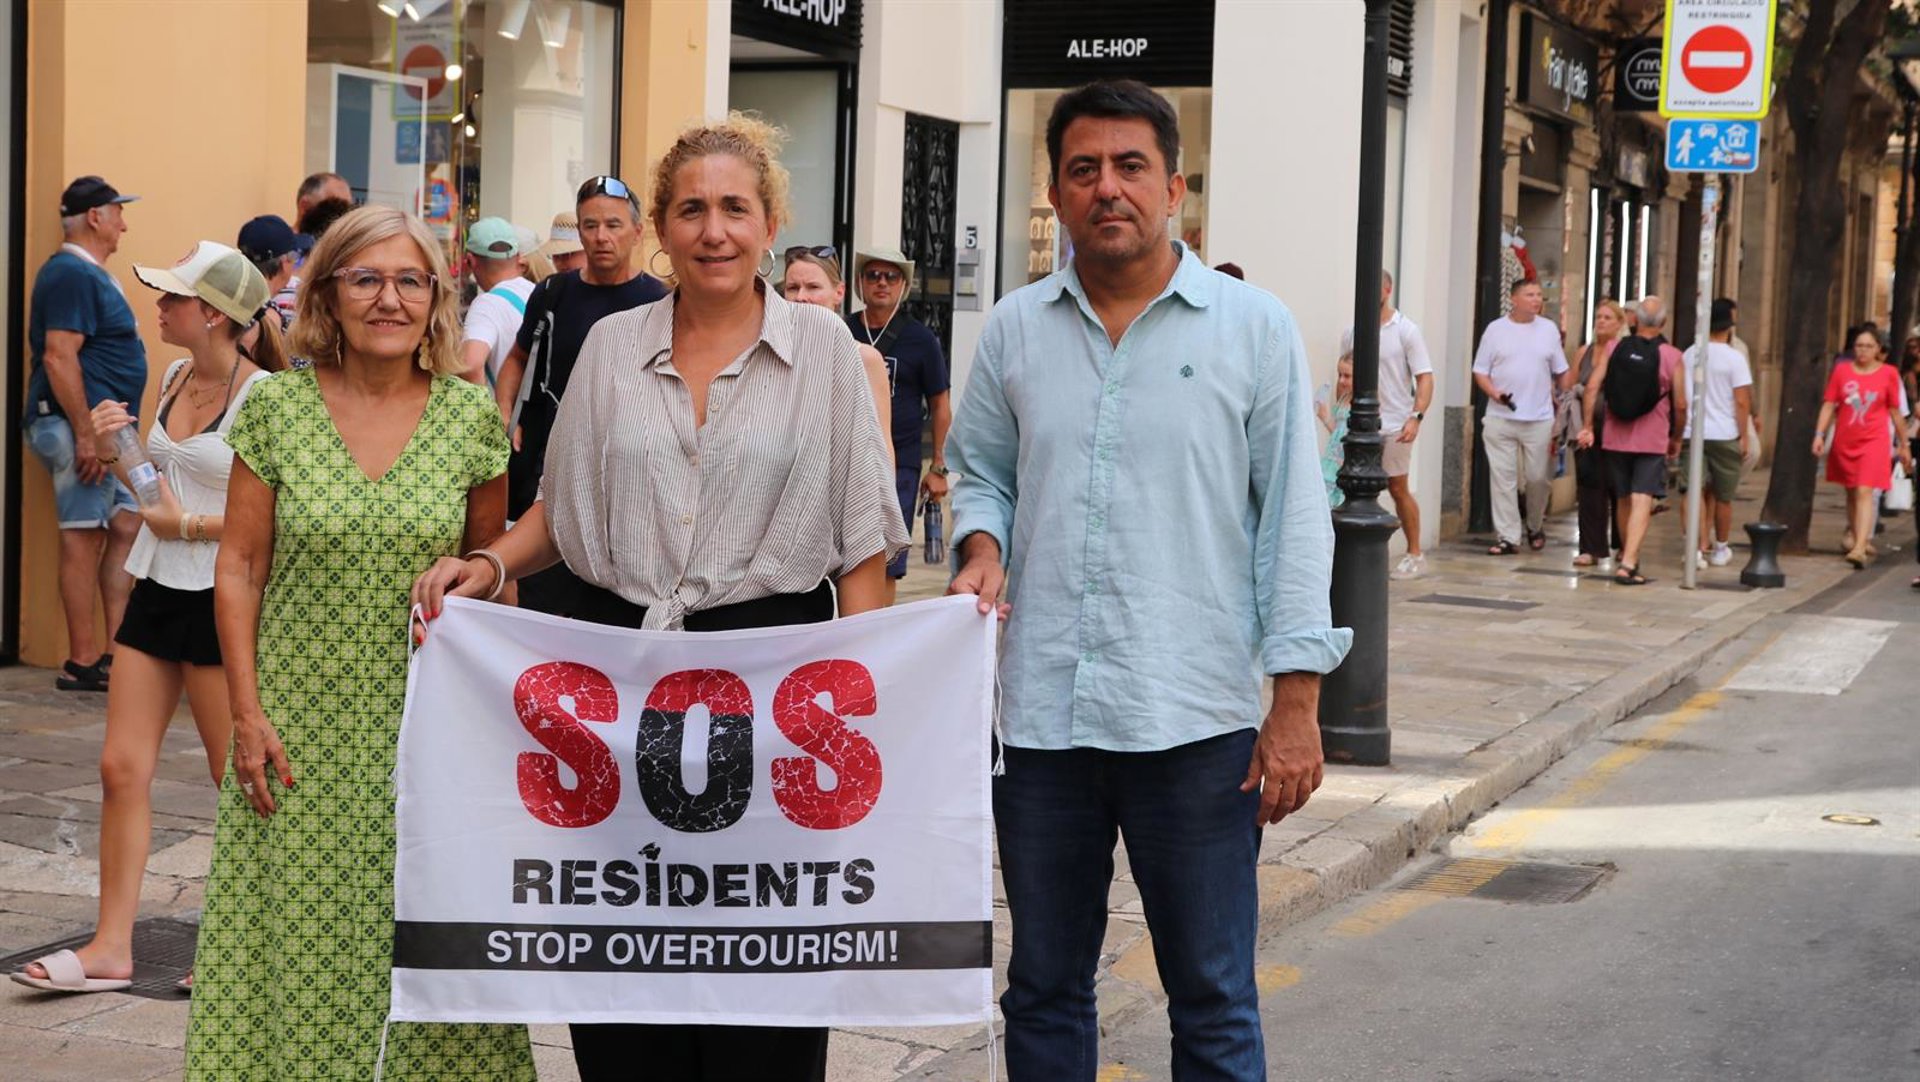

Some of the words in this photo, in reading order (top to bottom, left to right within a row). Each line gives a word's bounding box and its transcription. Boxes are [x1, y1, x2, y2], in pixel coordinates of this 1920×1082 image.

[763, 0, 846, 26] -HOP
[1067, 38, 1147, 58] ALE-HOP
[966, 229, 977, 248] 5
[513, 659, 883, 833] SOS
[486, 930, 593, 966] STOP
[605, 929, 899, 966] OVERTOURISM!
